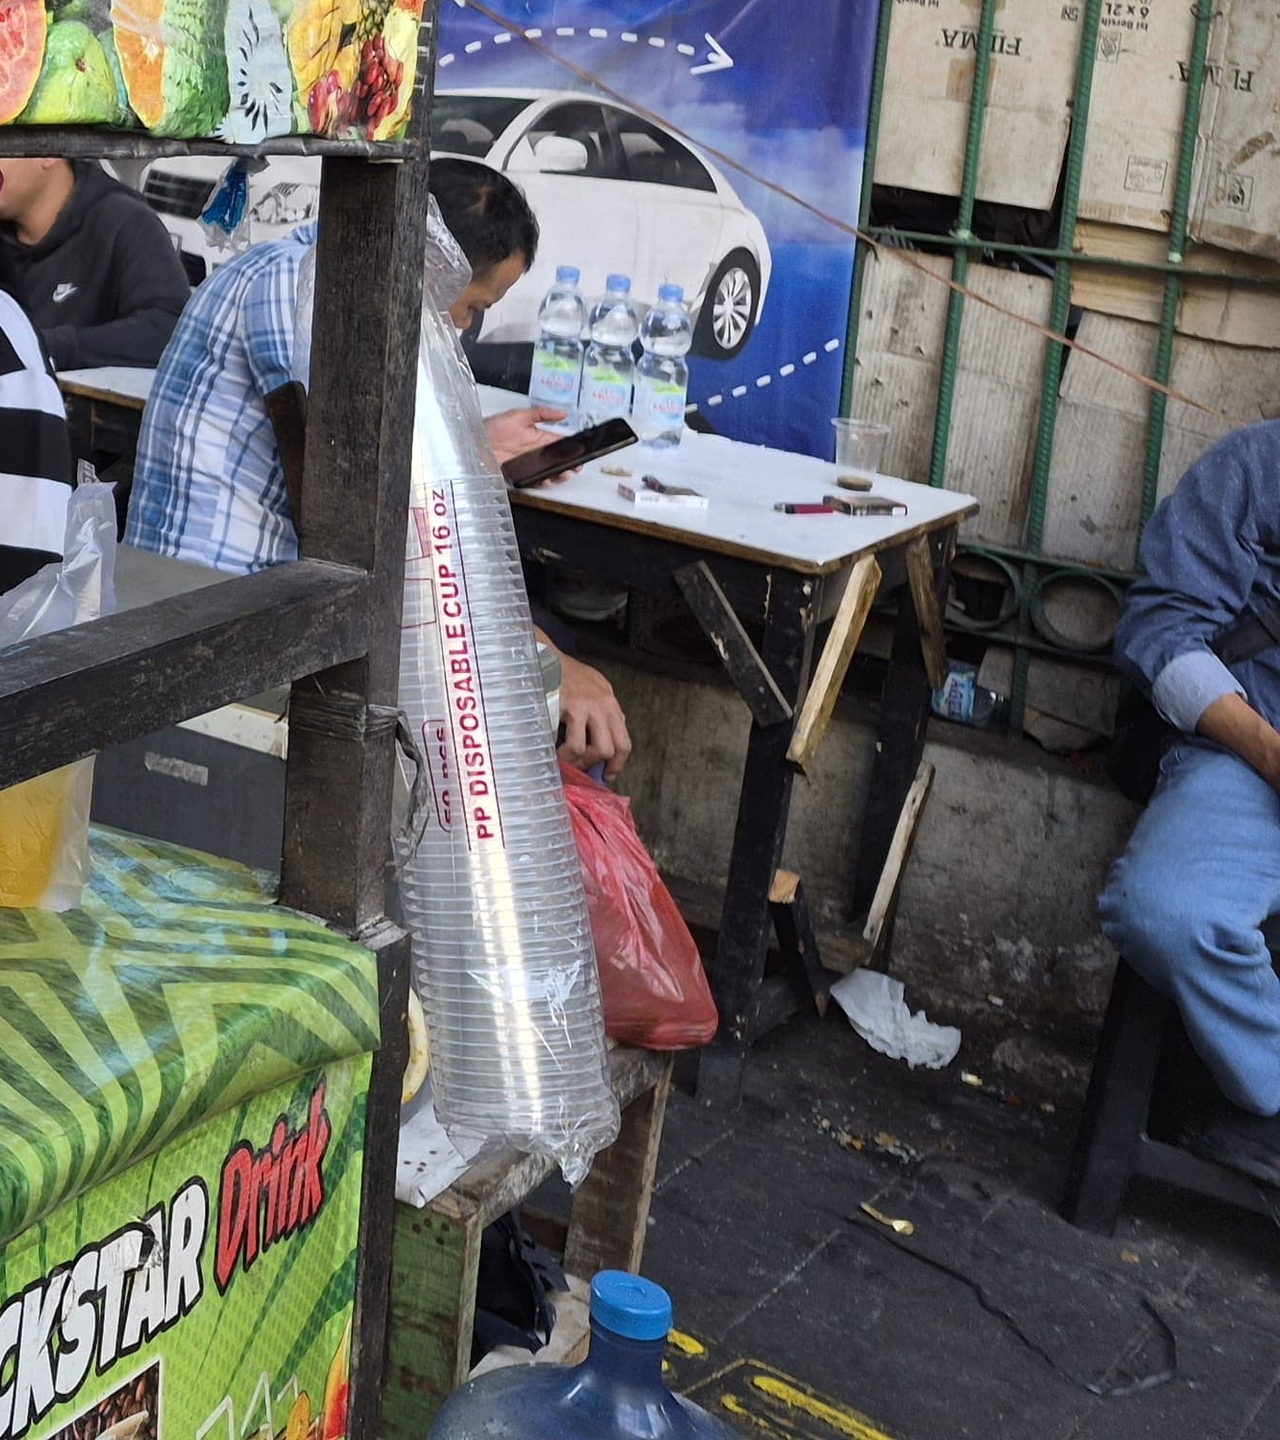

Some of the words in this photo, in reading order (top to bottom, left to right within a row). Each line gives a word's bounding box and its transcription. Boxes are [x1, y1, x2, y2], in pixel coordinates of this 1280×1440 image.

[940, 29, 1022, 57] FIMA
[433, 524, 453, 556] 16
[439, 564, 462, 619] CUP
[445, 622, 490, 797] DISPOSABLE
[475, 805, 495, 840] PP
[214, 1075, 331, 1295] Drink
